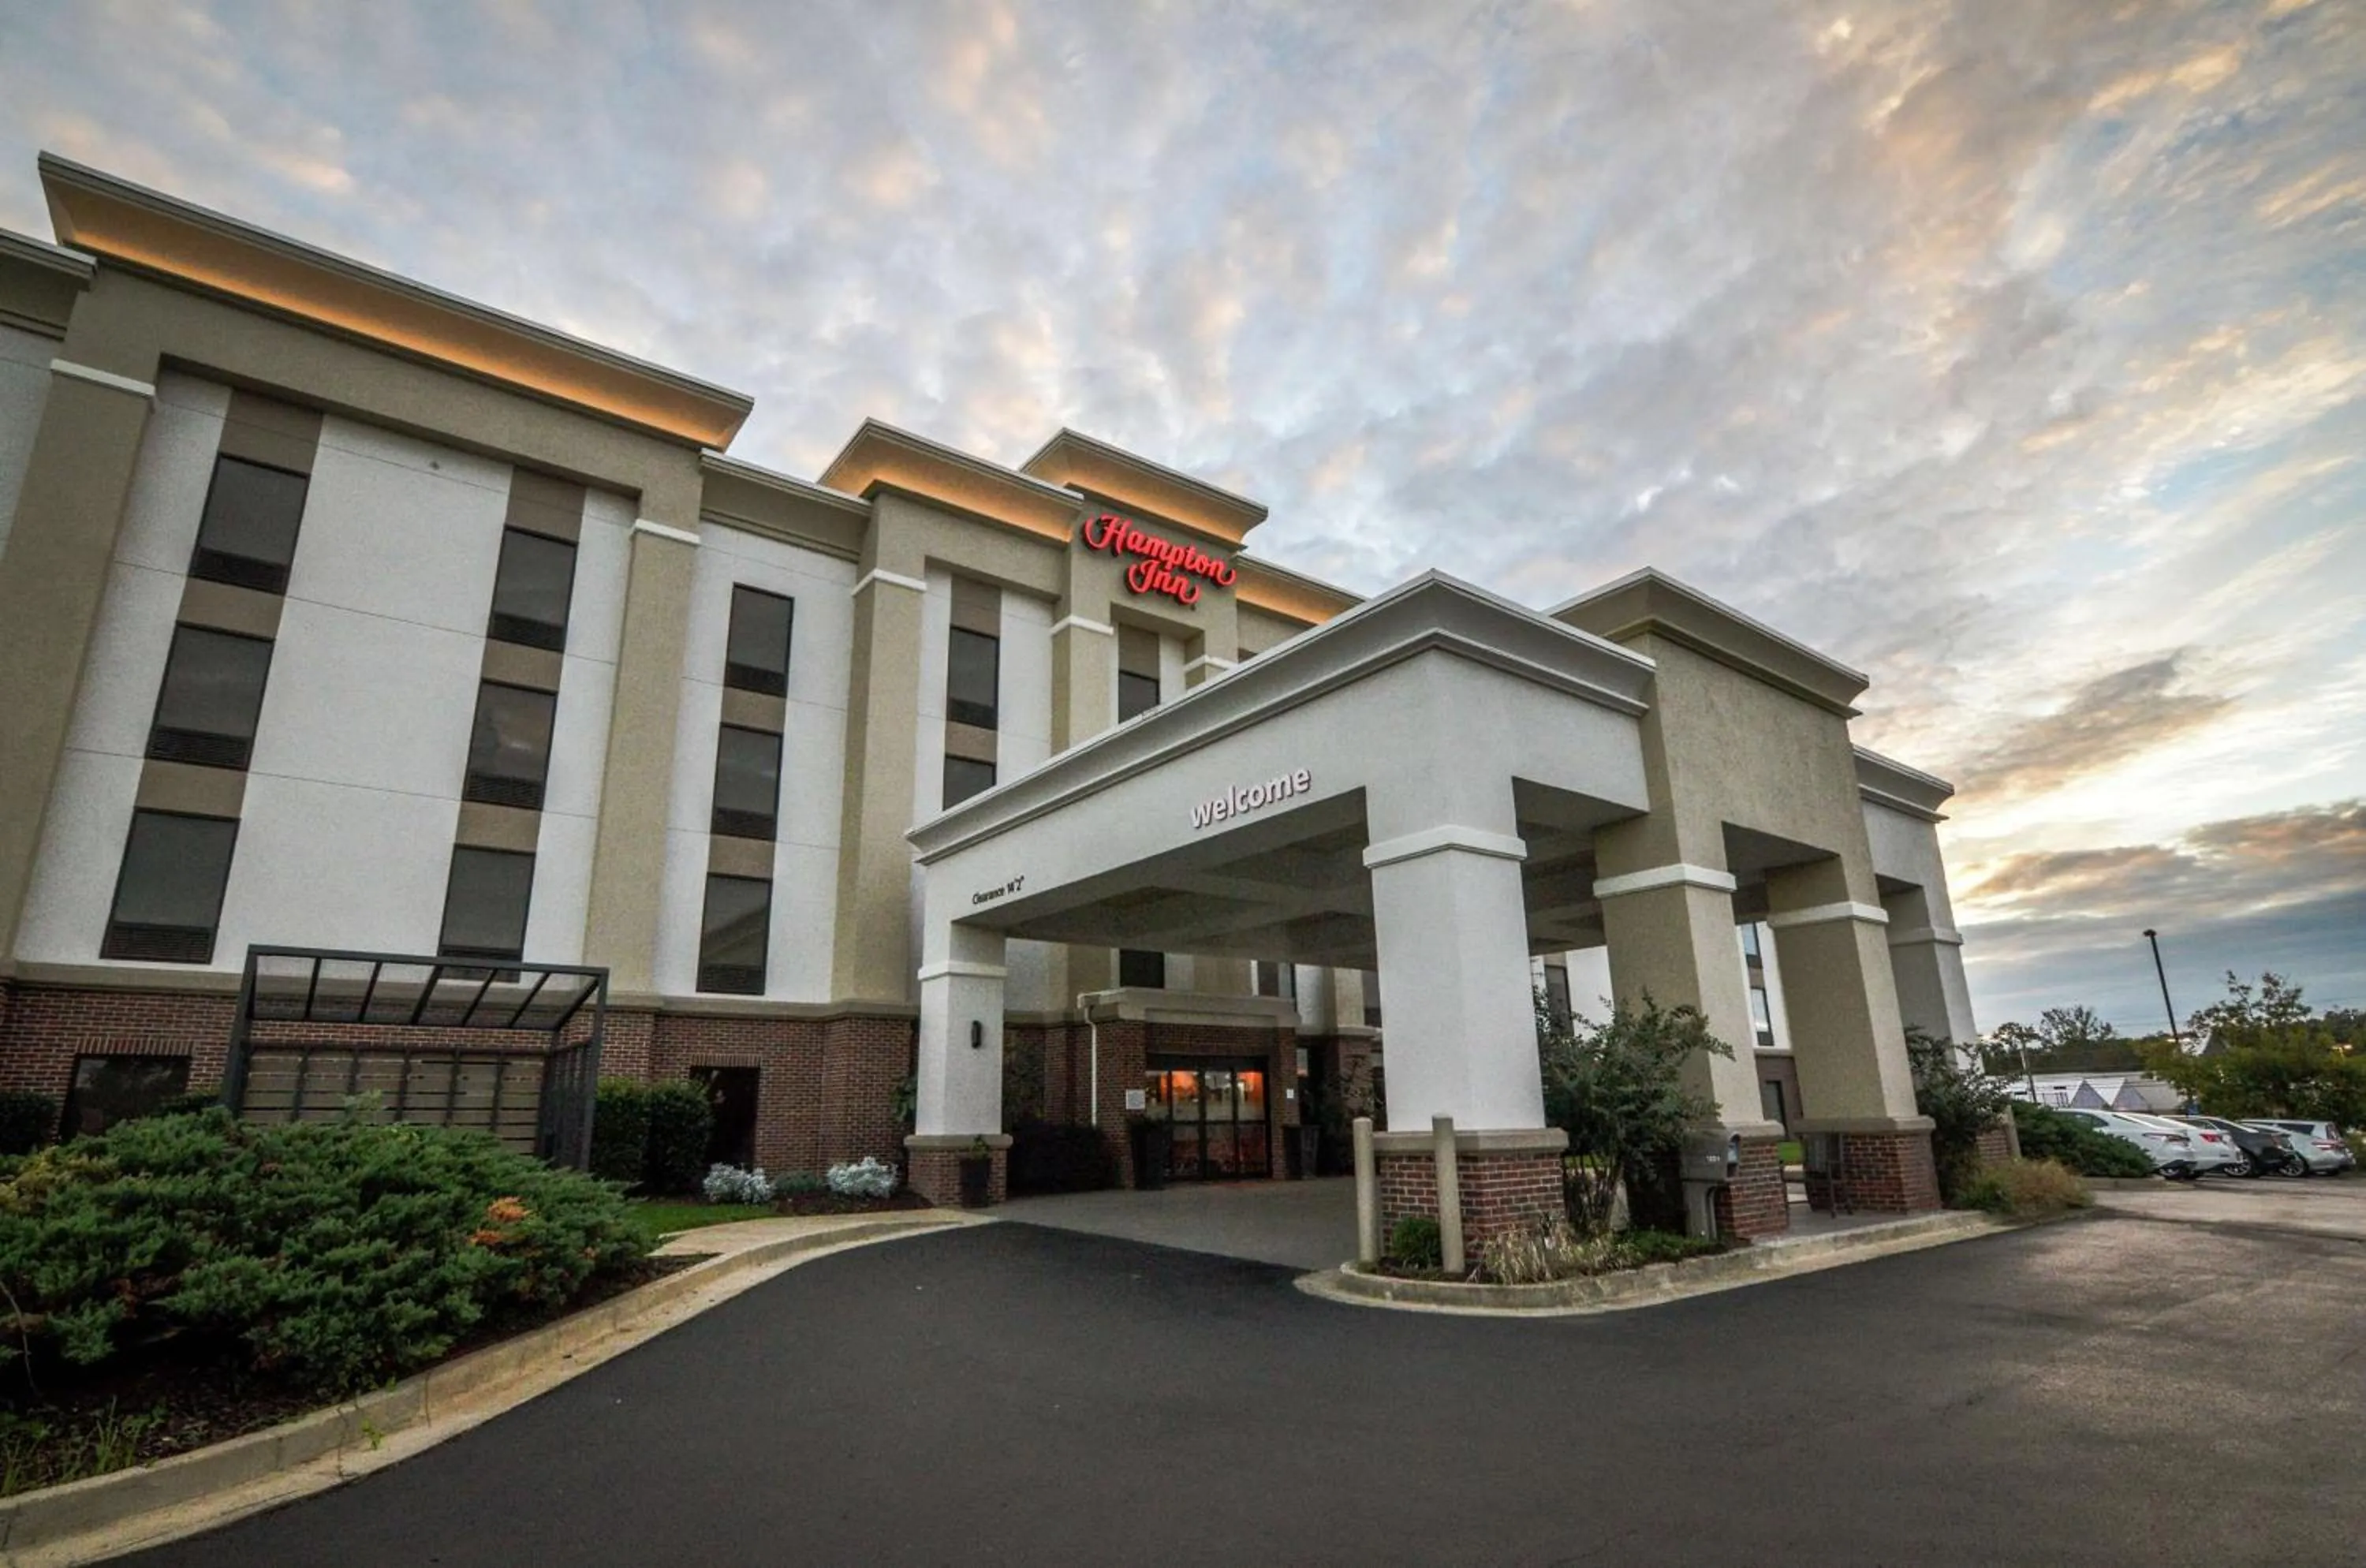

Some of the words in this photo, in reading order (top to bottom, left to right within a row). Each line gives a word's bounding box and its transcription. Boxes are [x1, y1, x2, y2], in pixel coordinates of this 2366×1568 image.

[1083, 513, 1237, 586] Hampton
[1127, 559, 1200, 604] Inn
[1191, 769, 1311, 829] welcome
